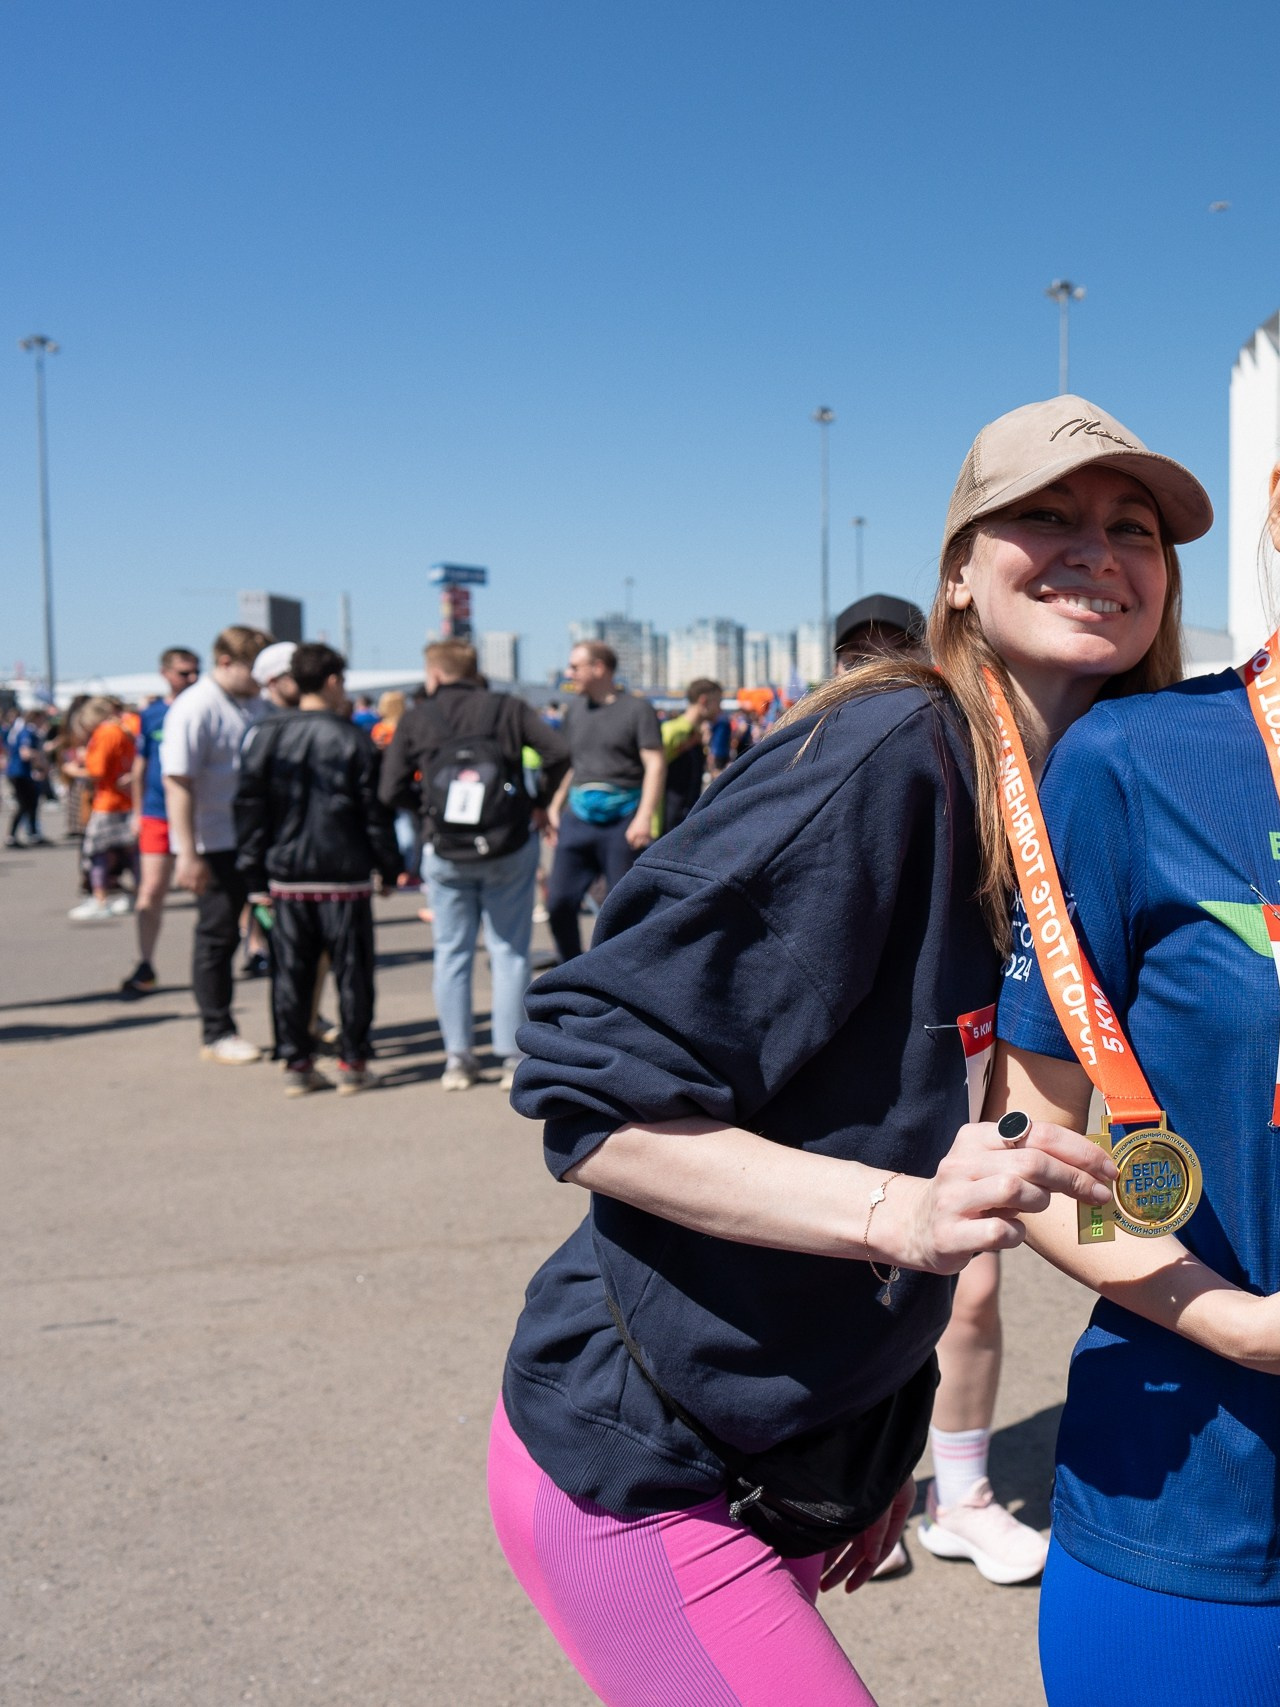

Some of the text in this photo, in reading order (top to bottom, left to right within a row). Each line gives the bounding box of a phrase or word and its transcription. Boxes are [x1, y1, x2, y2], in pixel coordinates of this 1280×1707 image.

[1031, 880, 1070, 959] ЭТОТ
[973, 1020, 992, 1039] 5 КМ
[1102, 1035, 1125, 1054] 5
[1125, 1171, 1181, 1194] ГЕРОЙ!
[1137, 1193, 1172, 1207] 10 ЛЕТ
